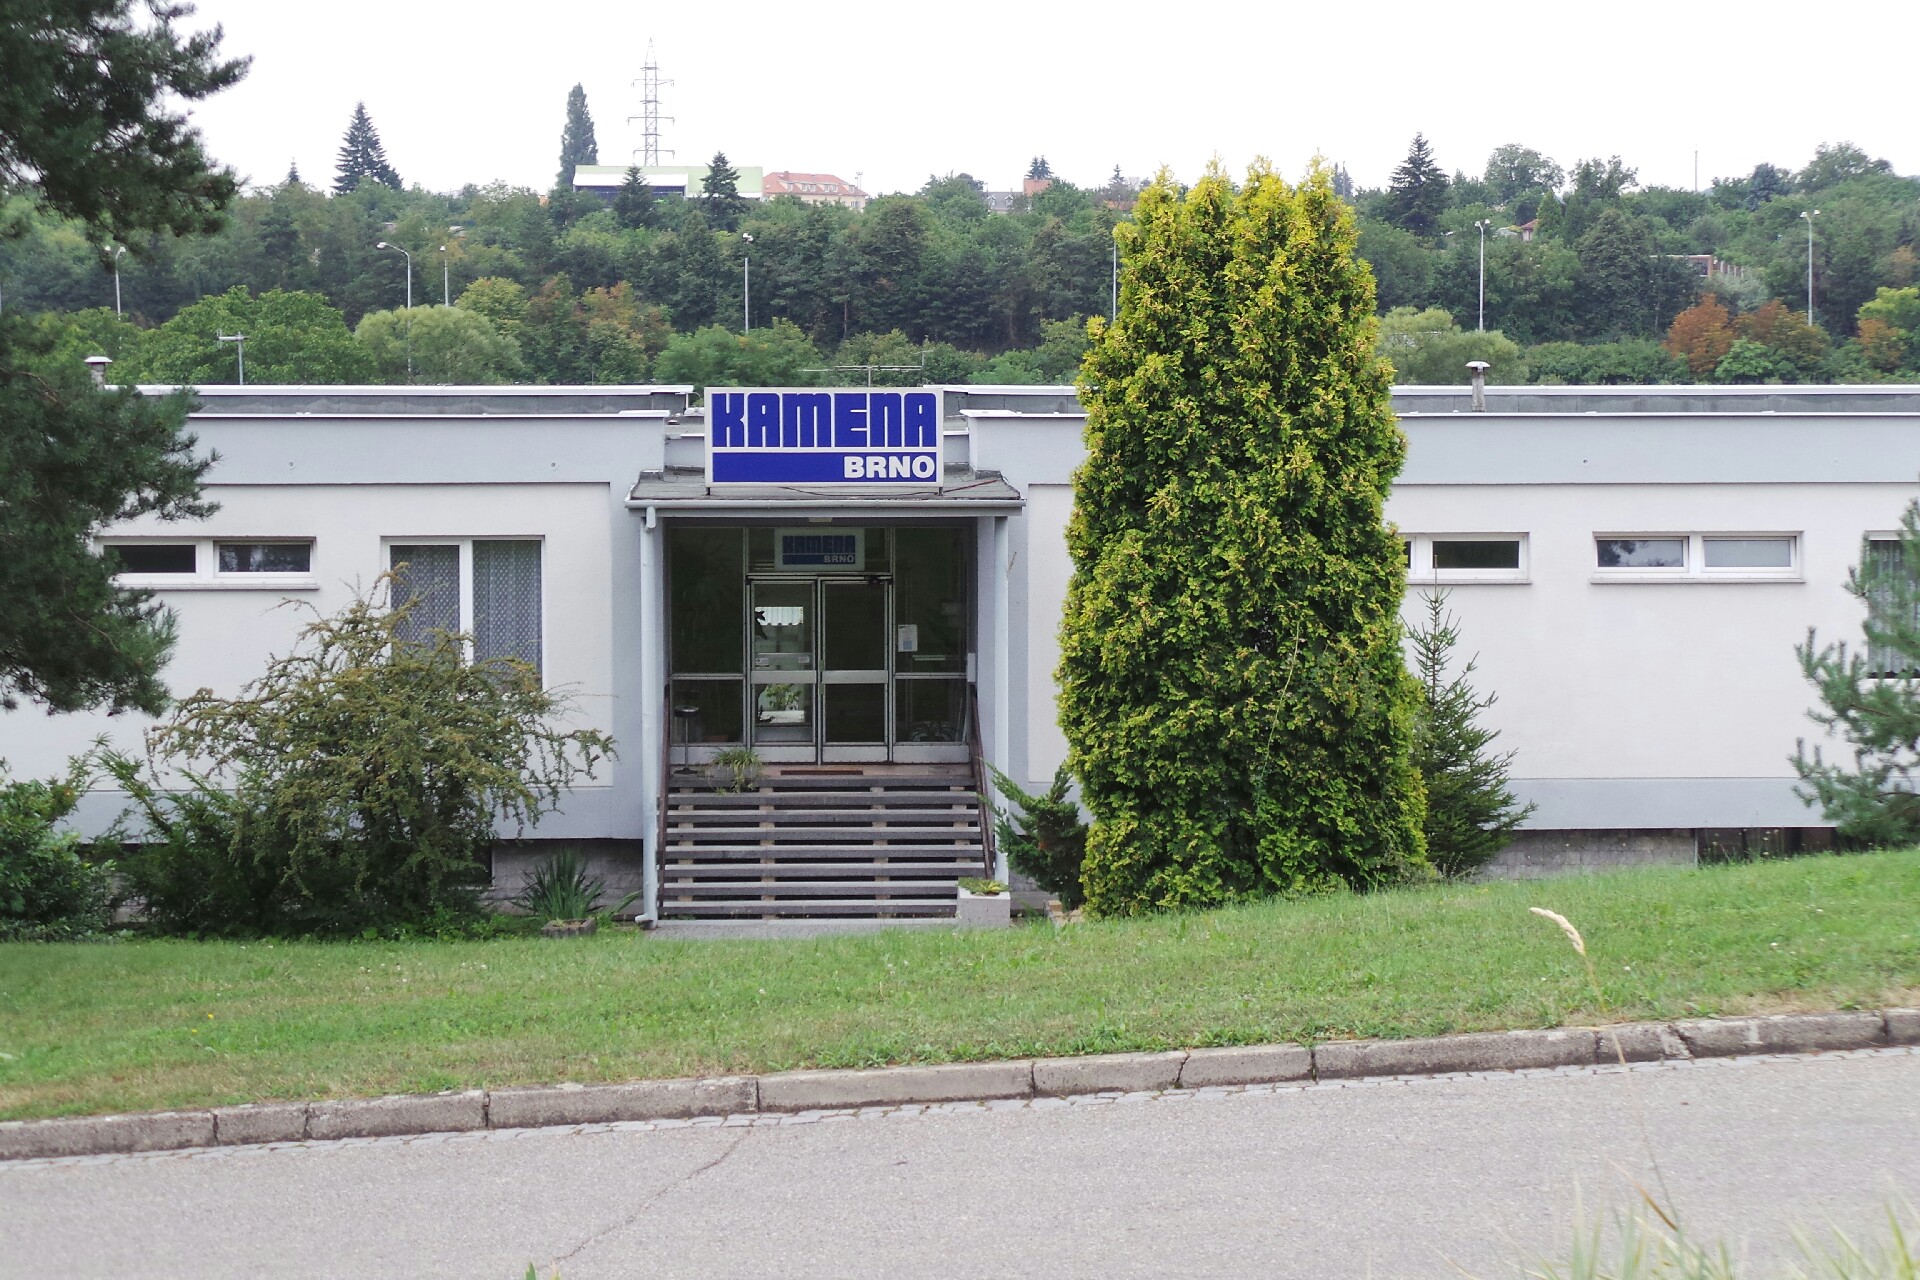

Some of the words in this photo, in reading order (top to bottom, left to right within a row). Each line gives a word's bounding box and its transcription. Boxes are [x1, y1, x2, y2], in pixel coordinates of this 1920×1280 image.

[711, 393, 937, 447] KAMENA
[844, 455, 935, 478] BRNO
[823, 555, 854, 563] BRNO
